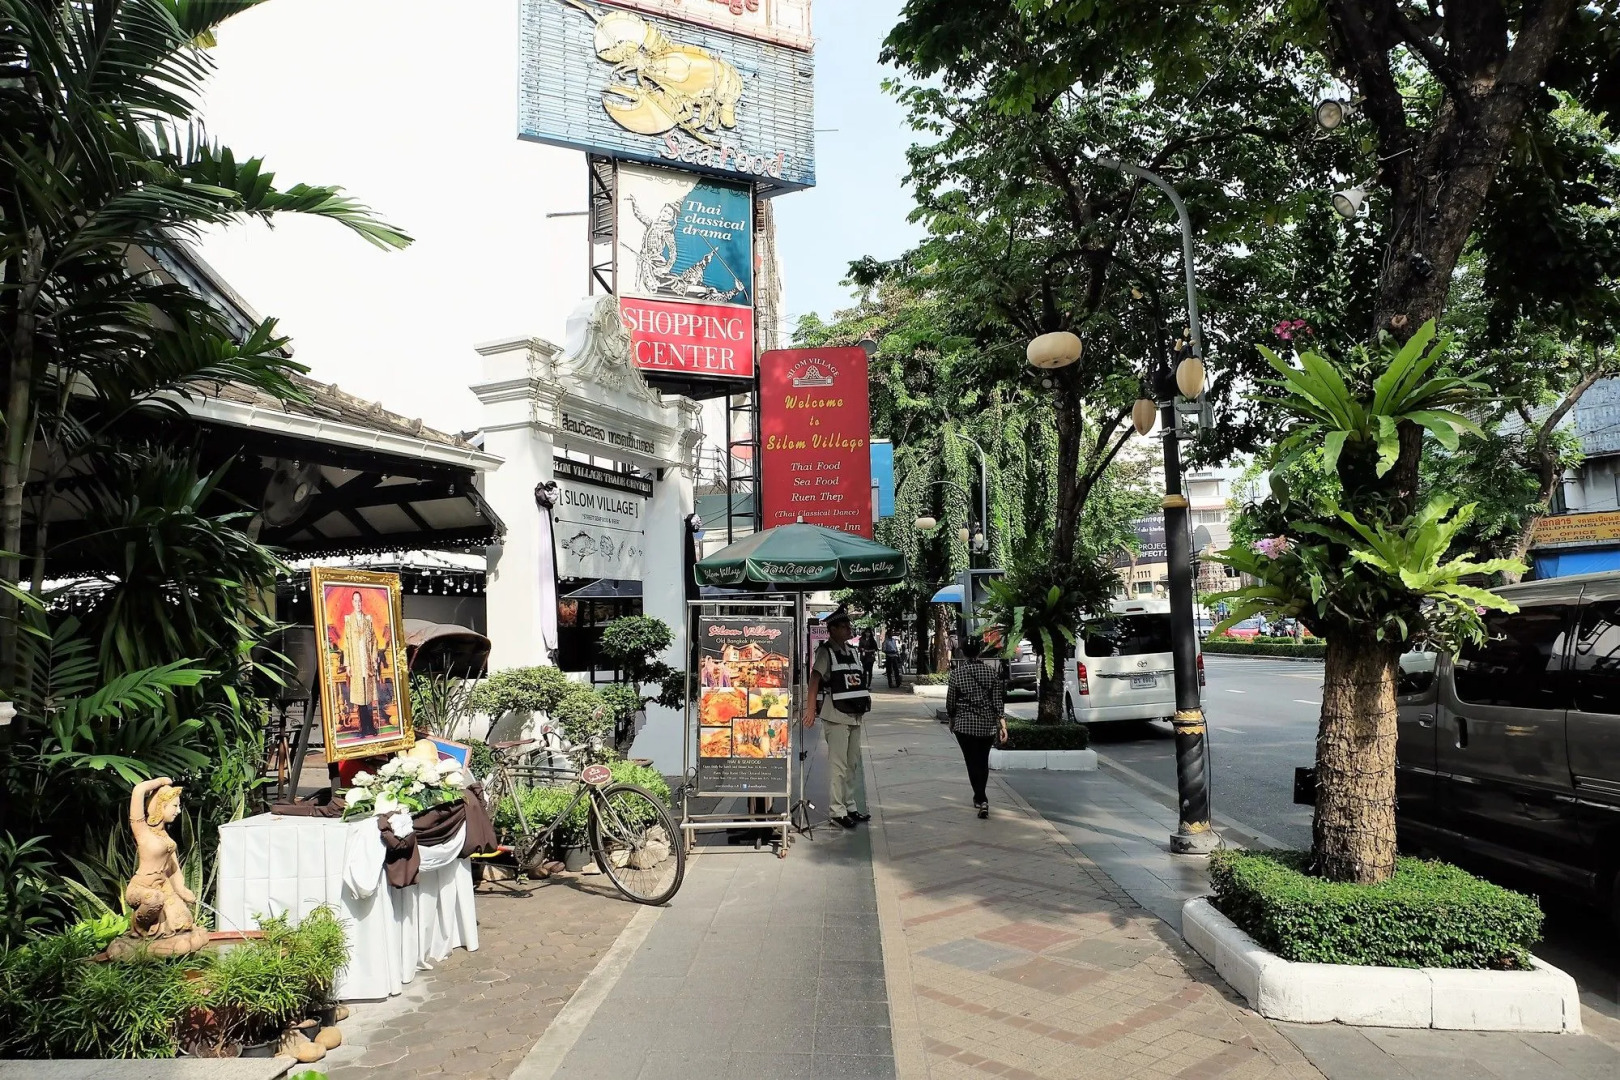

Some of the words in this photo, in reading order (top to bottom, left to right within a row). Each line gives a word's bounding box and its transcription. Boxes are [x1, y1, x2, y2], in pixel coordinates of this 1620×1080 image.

[686, 200, 722, 216] Thai
[684, 213, 746, 231] classical
[682, 224, 732, 241] drama
[619, 307, 745, 341] SHOPPING
[635, 339, 736, 371] CENTER
[787, 360, 807, 380] SILOM
[808, 358, 840, 378] VILLAGE
[784, 393, 844, 409] Welcome
[809, 416, 820, 426] to
[766, 434, 806, 450] Silom
[811, 432, 864, 453] Village
[573, 465, 603, 482] VILLAGE
[790, 462, 813, 471] Thai
[816, 461, 841, 471] Food
[793, 477, 811, 486] Sea
[814, 476, 839, 486] Food
[564, 489, 595, 509] SILOM
[596, 496, 634, 516] VILLAGE
[791, 492, 816, 502] Ruen
[820, 491, 844, 503] Thep
[774, 510, 795, 518] (Thai
[797, 509, 830, 517] Classical
[833, 508, 860, 518] Dance)
[843, 522, 861, 531] Inn
[1559, 529, 1597, 537] OFFICE
[849, 563, 871, 575] Silom
[872, 561, 895, 574] Village
[708, 625, 742, 637] Silom
[742, 625, 782, 640] Village
